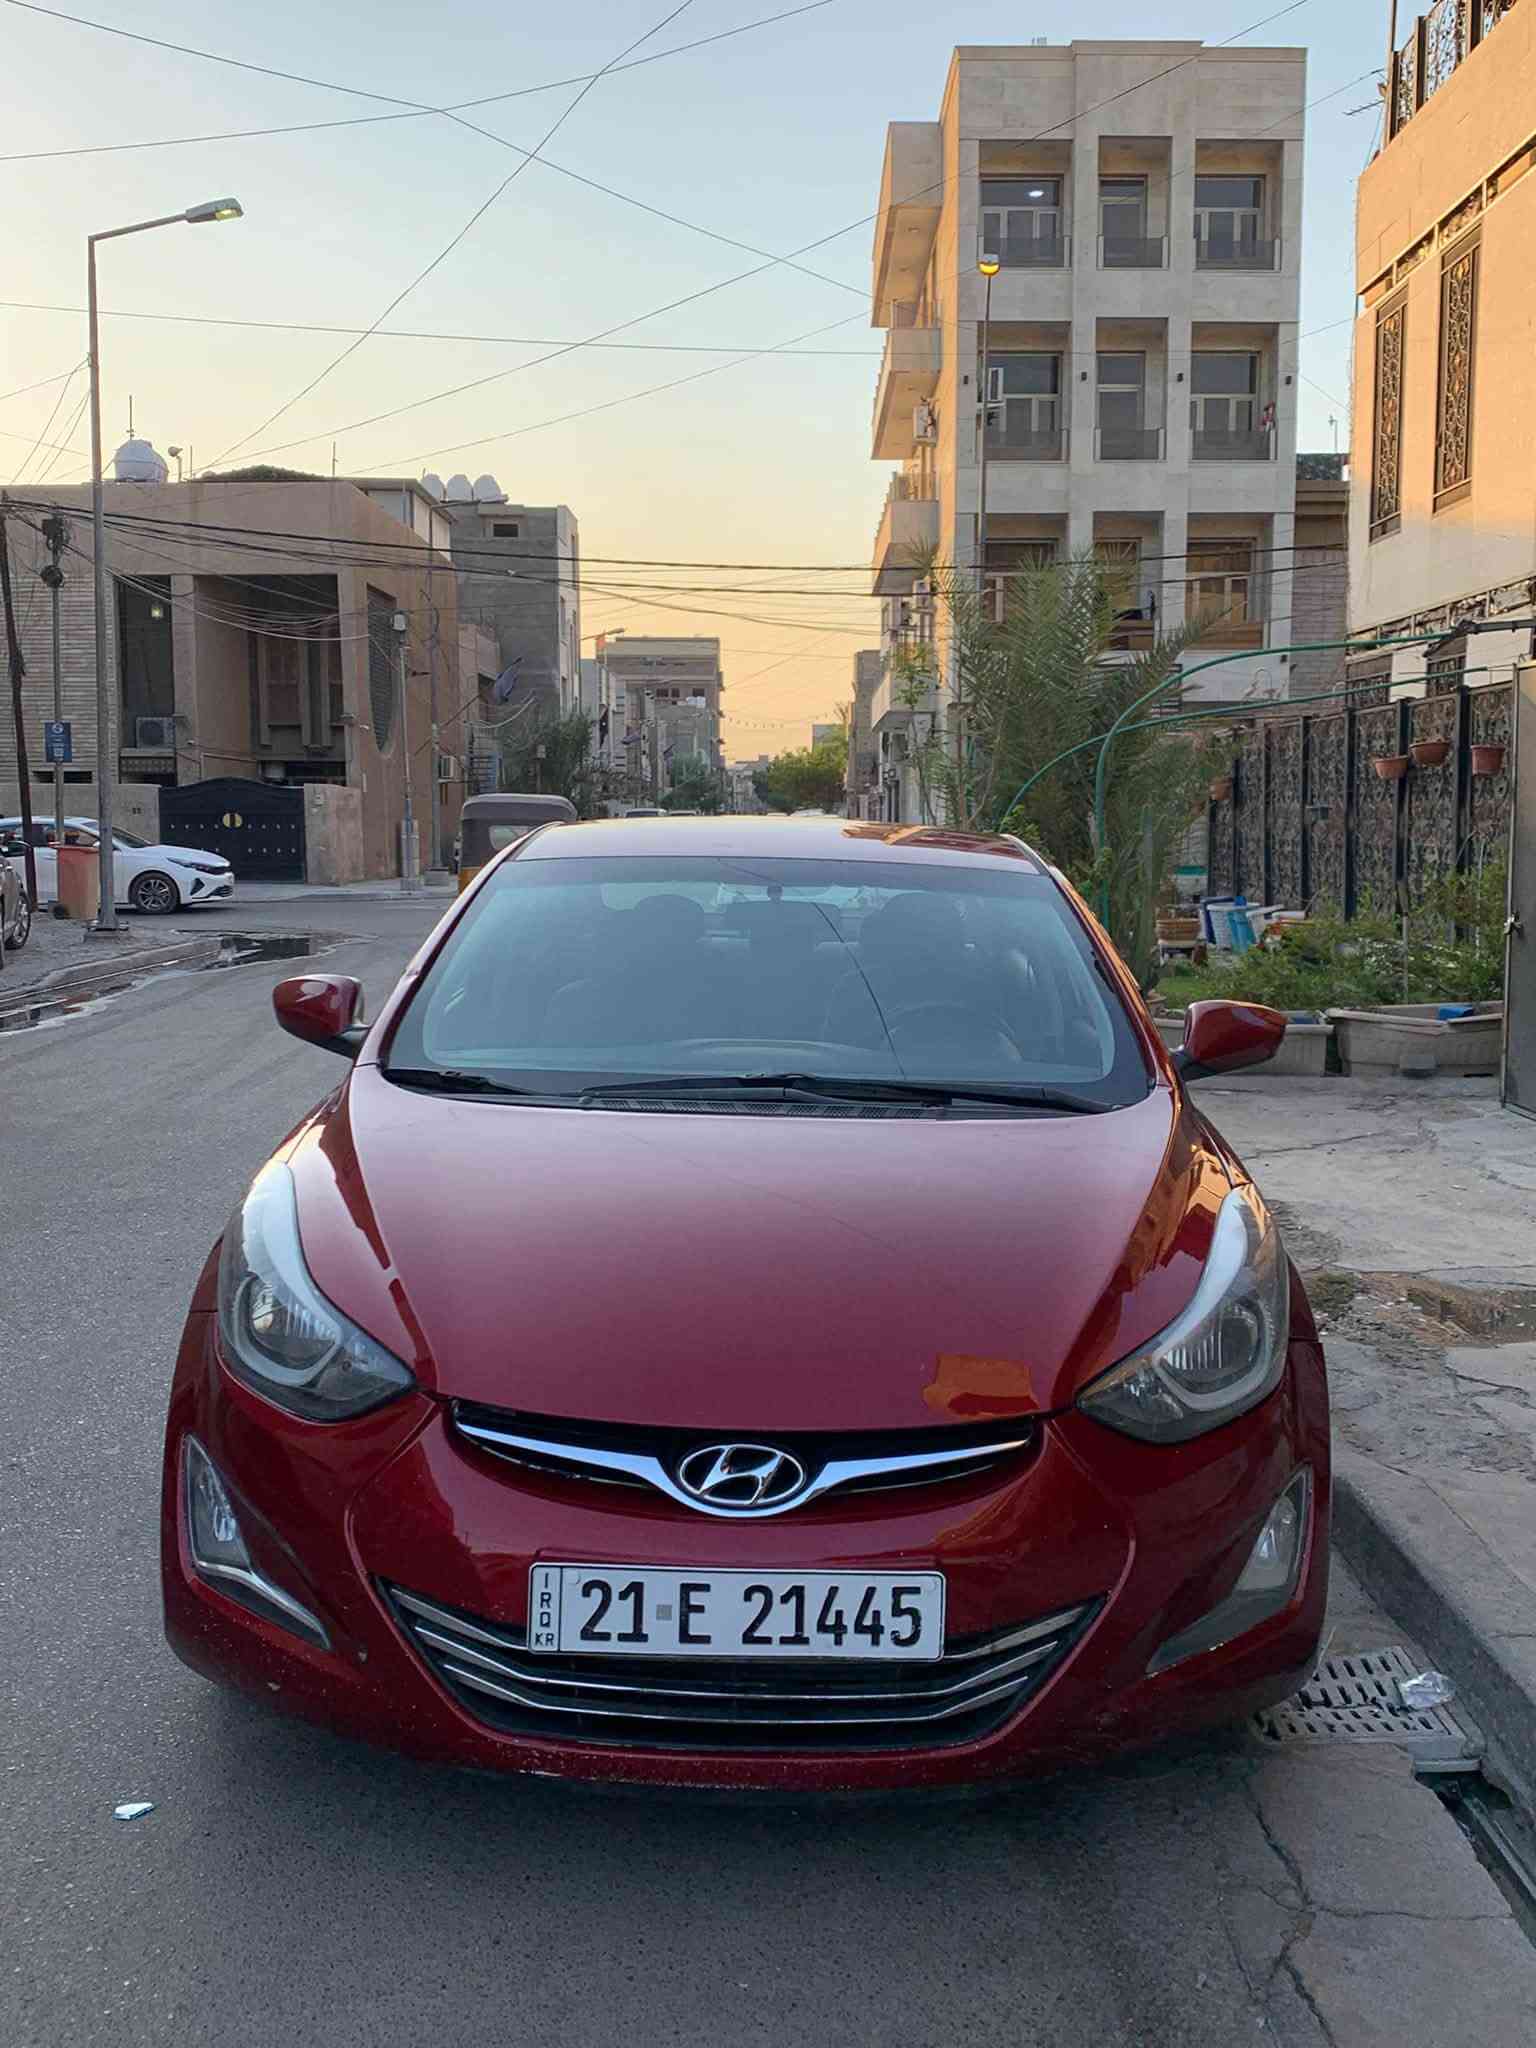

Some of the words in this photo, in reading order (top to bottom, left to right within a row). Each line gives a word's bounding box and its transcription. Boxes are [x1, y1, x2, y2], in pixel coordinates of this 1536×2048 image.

[580, 1579, 649, 1643] 21
[678, 1582, 711, 1644] E
[741, 1584, 922, 1647] 21445
[534, 1632, 555, 1647] KR
